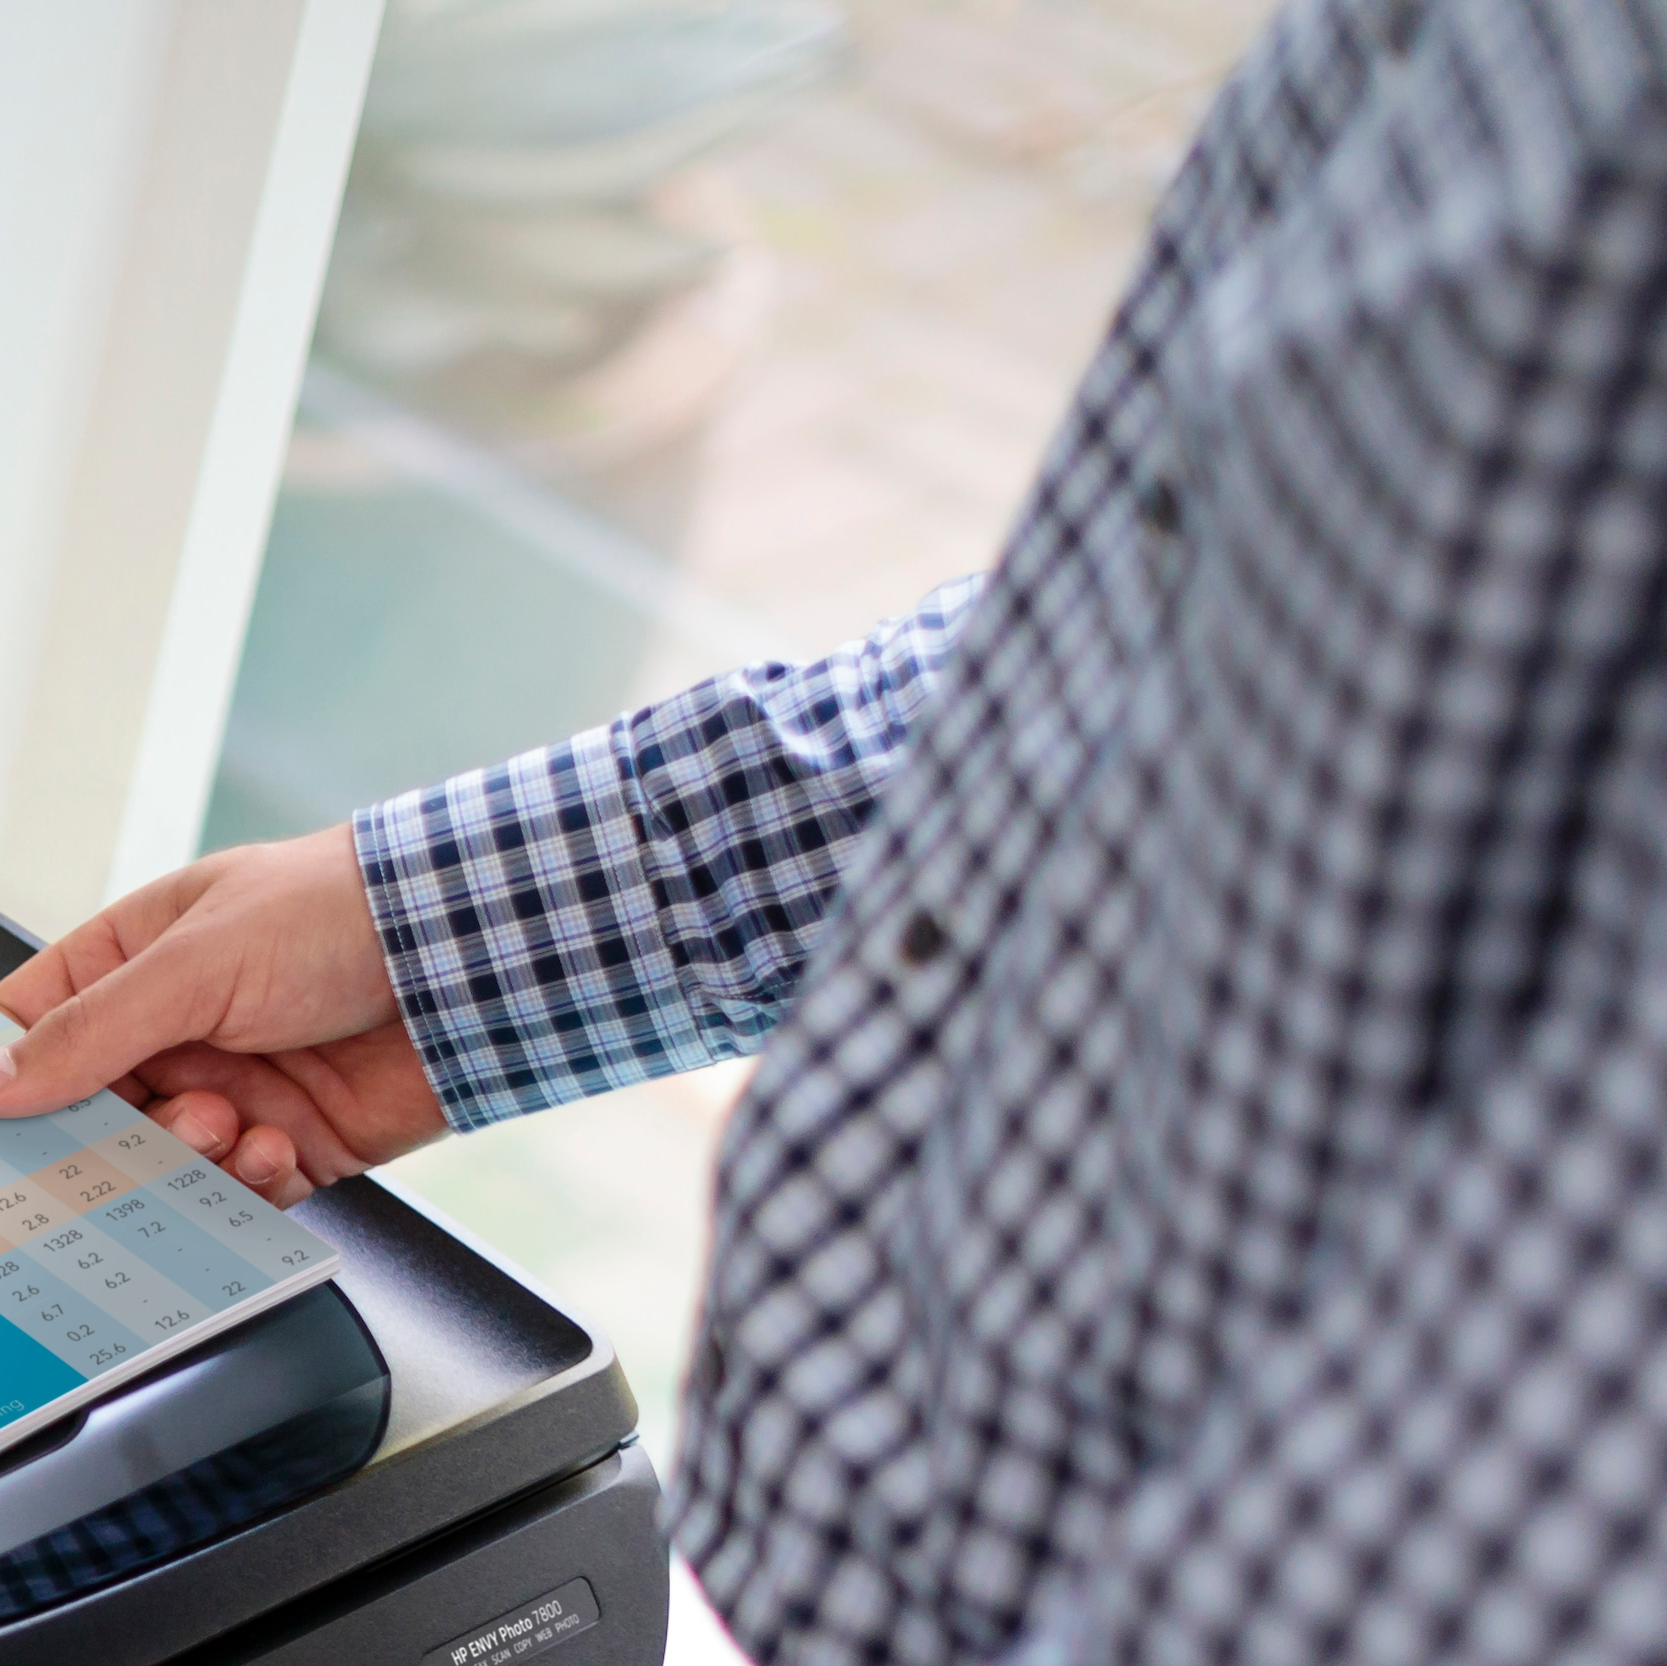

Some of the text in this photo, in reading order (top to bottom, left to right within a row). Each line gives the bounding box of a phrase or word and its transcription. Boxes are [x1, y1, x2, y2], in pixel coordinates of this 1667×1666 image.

[58, 1163, 83, 1180] 22
[117, 1133, 146, 1150] 9.2
[20, 1212, 50, 1232] 2.8
[79, 1180, 117, 1203] 2.22
[42, 1228, 83, 1252] 1328
[105, 1198, 145, 1221] 1398
[166, 1168, 207, 1191] 1228
[11, 1284, 40, 1303] 2.6
[76, 1251, 104, 1270] 6.2
[136, 1220, 167, 1238] 7.2
[198, 1190, 228, 1208] 9.2
[40, 1302, 64, 1322] 6.7
[104, 1271, 131, 1289] 6.2
[227, 1209, 254, 1228] 6.5
[65, 1323, 95, 1342] 0.2
[88, 1342, 127, 1366] 25.6
[153, 1309, 190, 1330] 12.6
[221, 1280, 247, 1297] 22
[280, 1249, 310, 1266] 9.2
[451, 1600, 563, 1666] HP ENVY Photo 7800
[491, 1649, 511, 1665] SCAN
[513, 1638, 533, 1654] COPY
[535, 1628, 553, 1643] WEB
[555, 1614, 580, 1633] PHOTO
